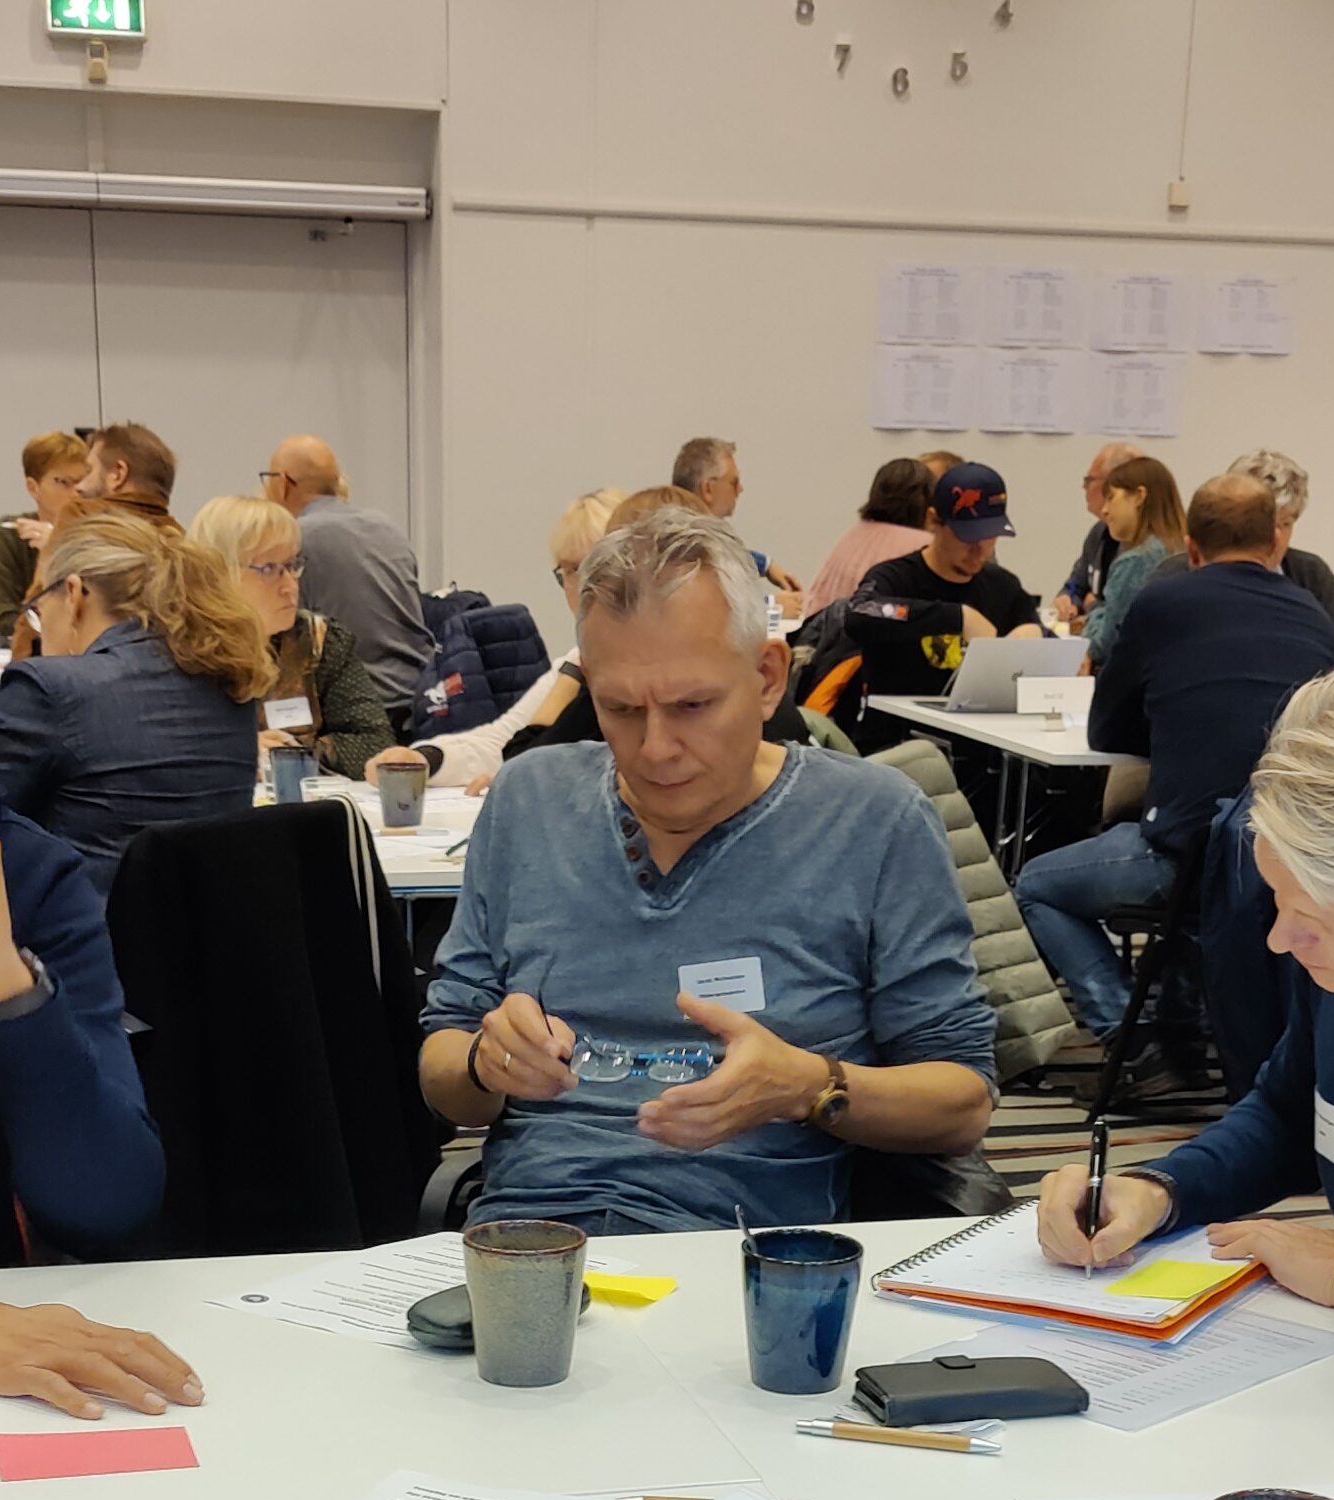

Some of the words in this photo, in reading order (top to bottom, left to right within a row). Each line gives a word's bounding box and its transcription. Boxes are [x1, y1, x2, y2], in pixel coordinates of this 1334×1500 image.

[834, 44, 851, 79] 7
[951, 52, 968, 82] 5
[892, 67, 910, 99] 6
